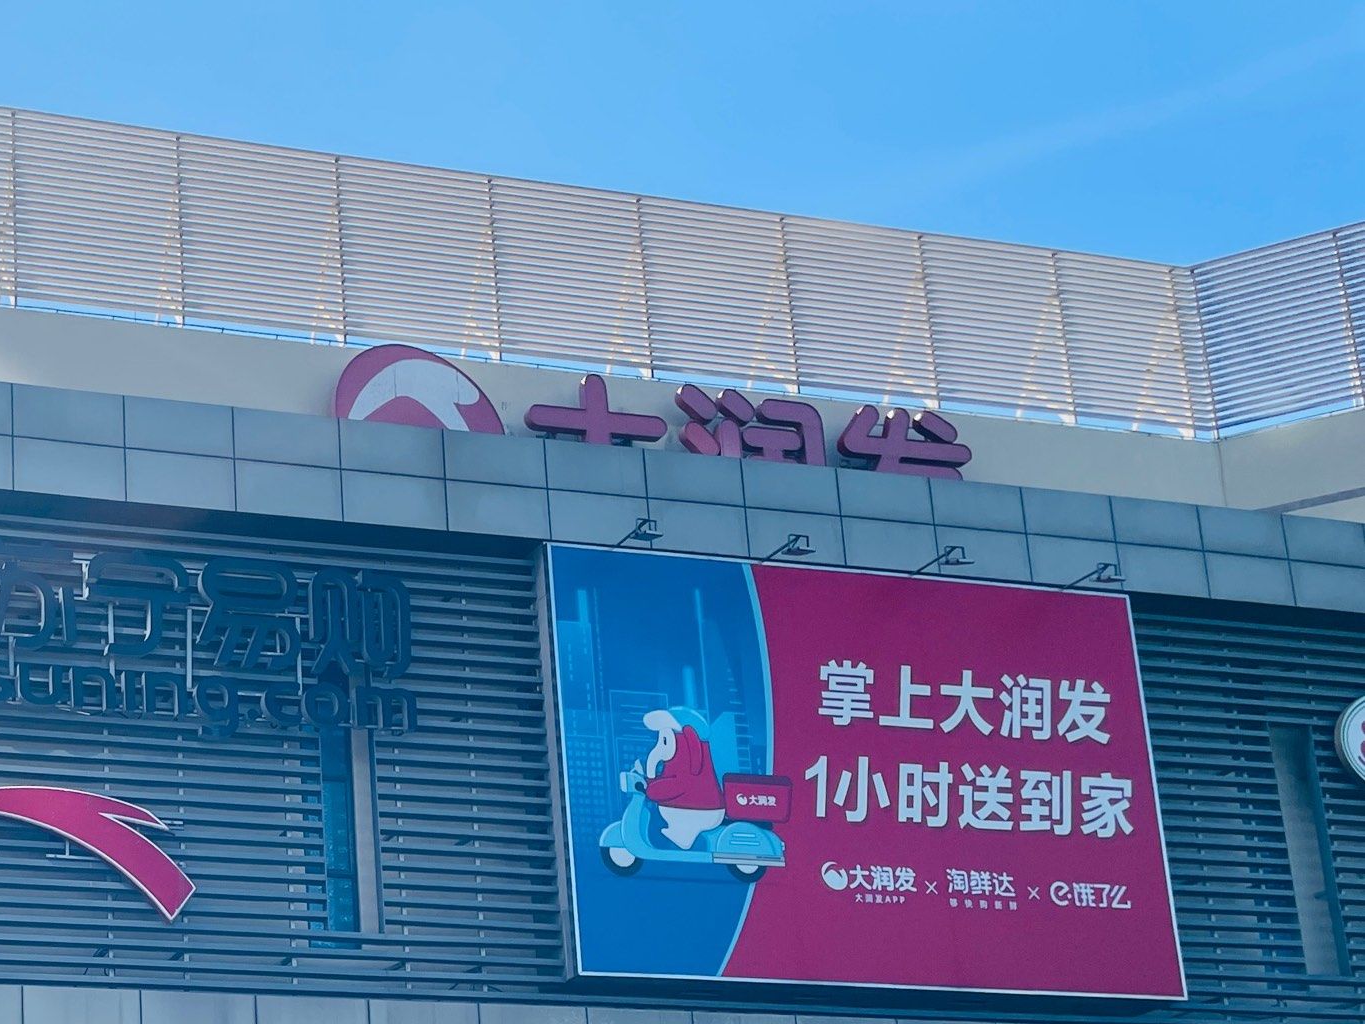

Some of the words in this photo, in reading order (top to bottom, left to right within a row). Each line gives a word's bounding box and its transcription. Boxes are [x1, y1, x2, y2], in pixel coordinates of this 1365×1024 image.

[818, 659, 1112, 745] 掌上大润发
[805, 756, 1135, 839] 1小时送到家
[849, 864, 918, 893] 大润发
[946, 868, 1016, 898] 淘鲜达
